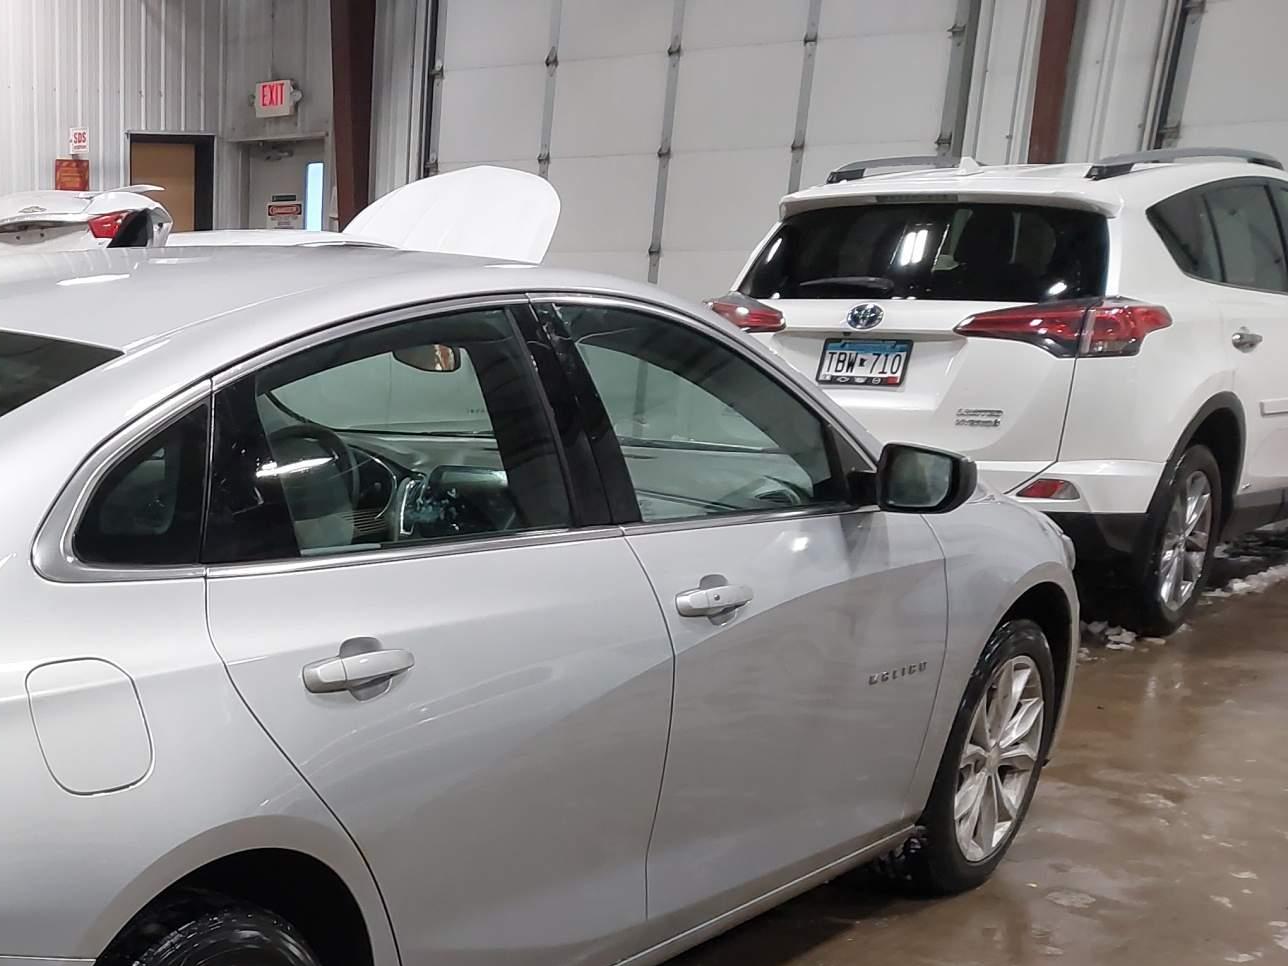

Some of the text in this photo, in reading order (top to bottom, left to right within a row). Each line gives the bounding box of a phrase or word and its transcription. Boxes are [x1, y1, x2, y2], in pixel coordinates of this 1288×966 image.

[262, 82, 285, 107] EXIT
[73, 131, 87, 144] SDS
[826, 352, 903, 375] TBW 710
